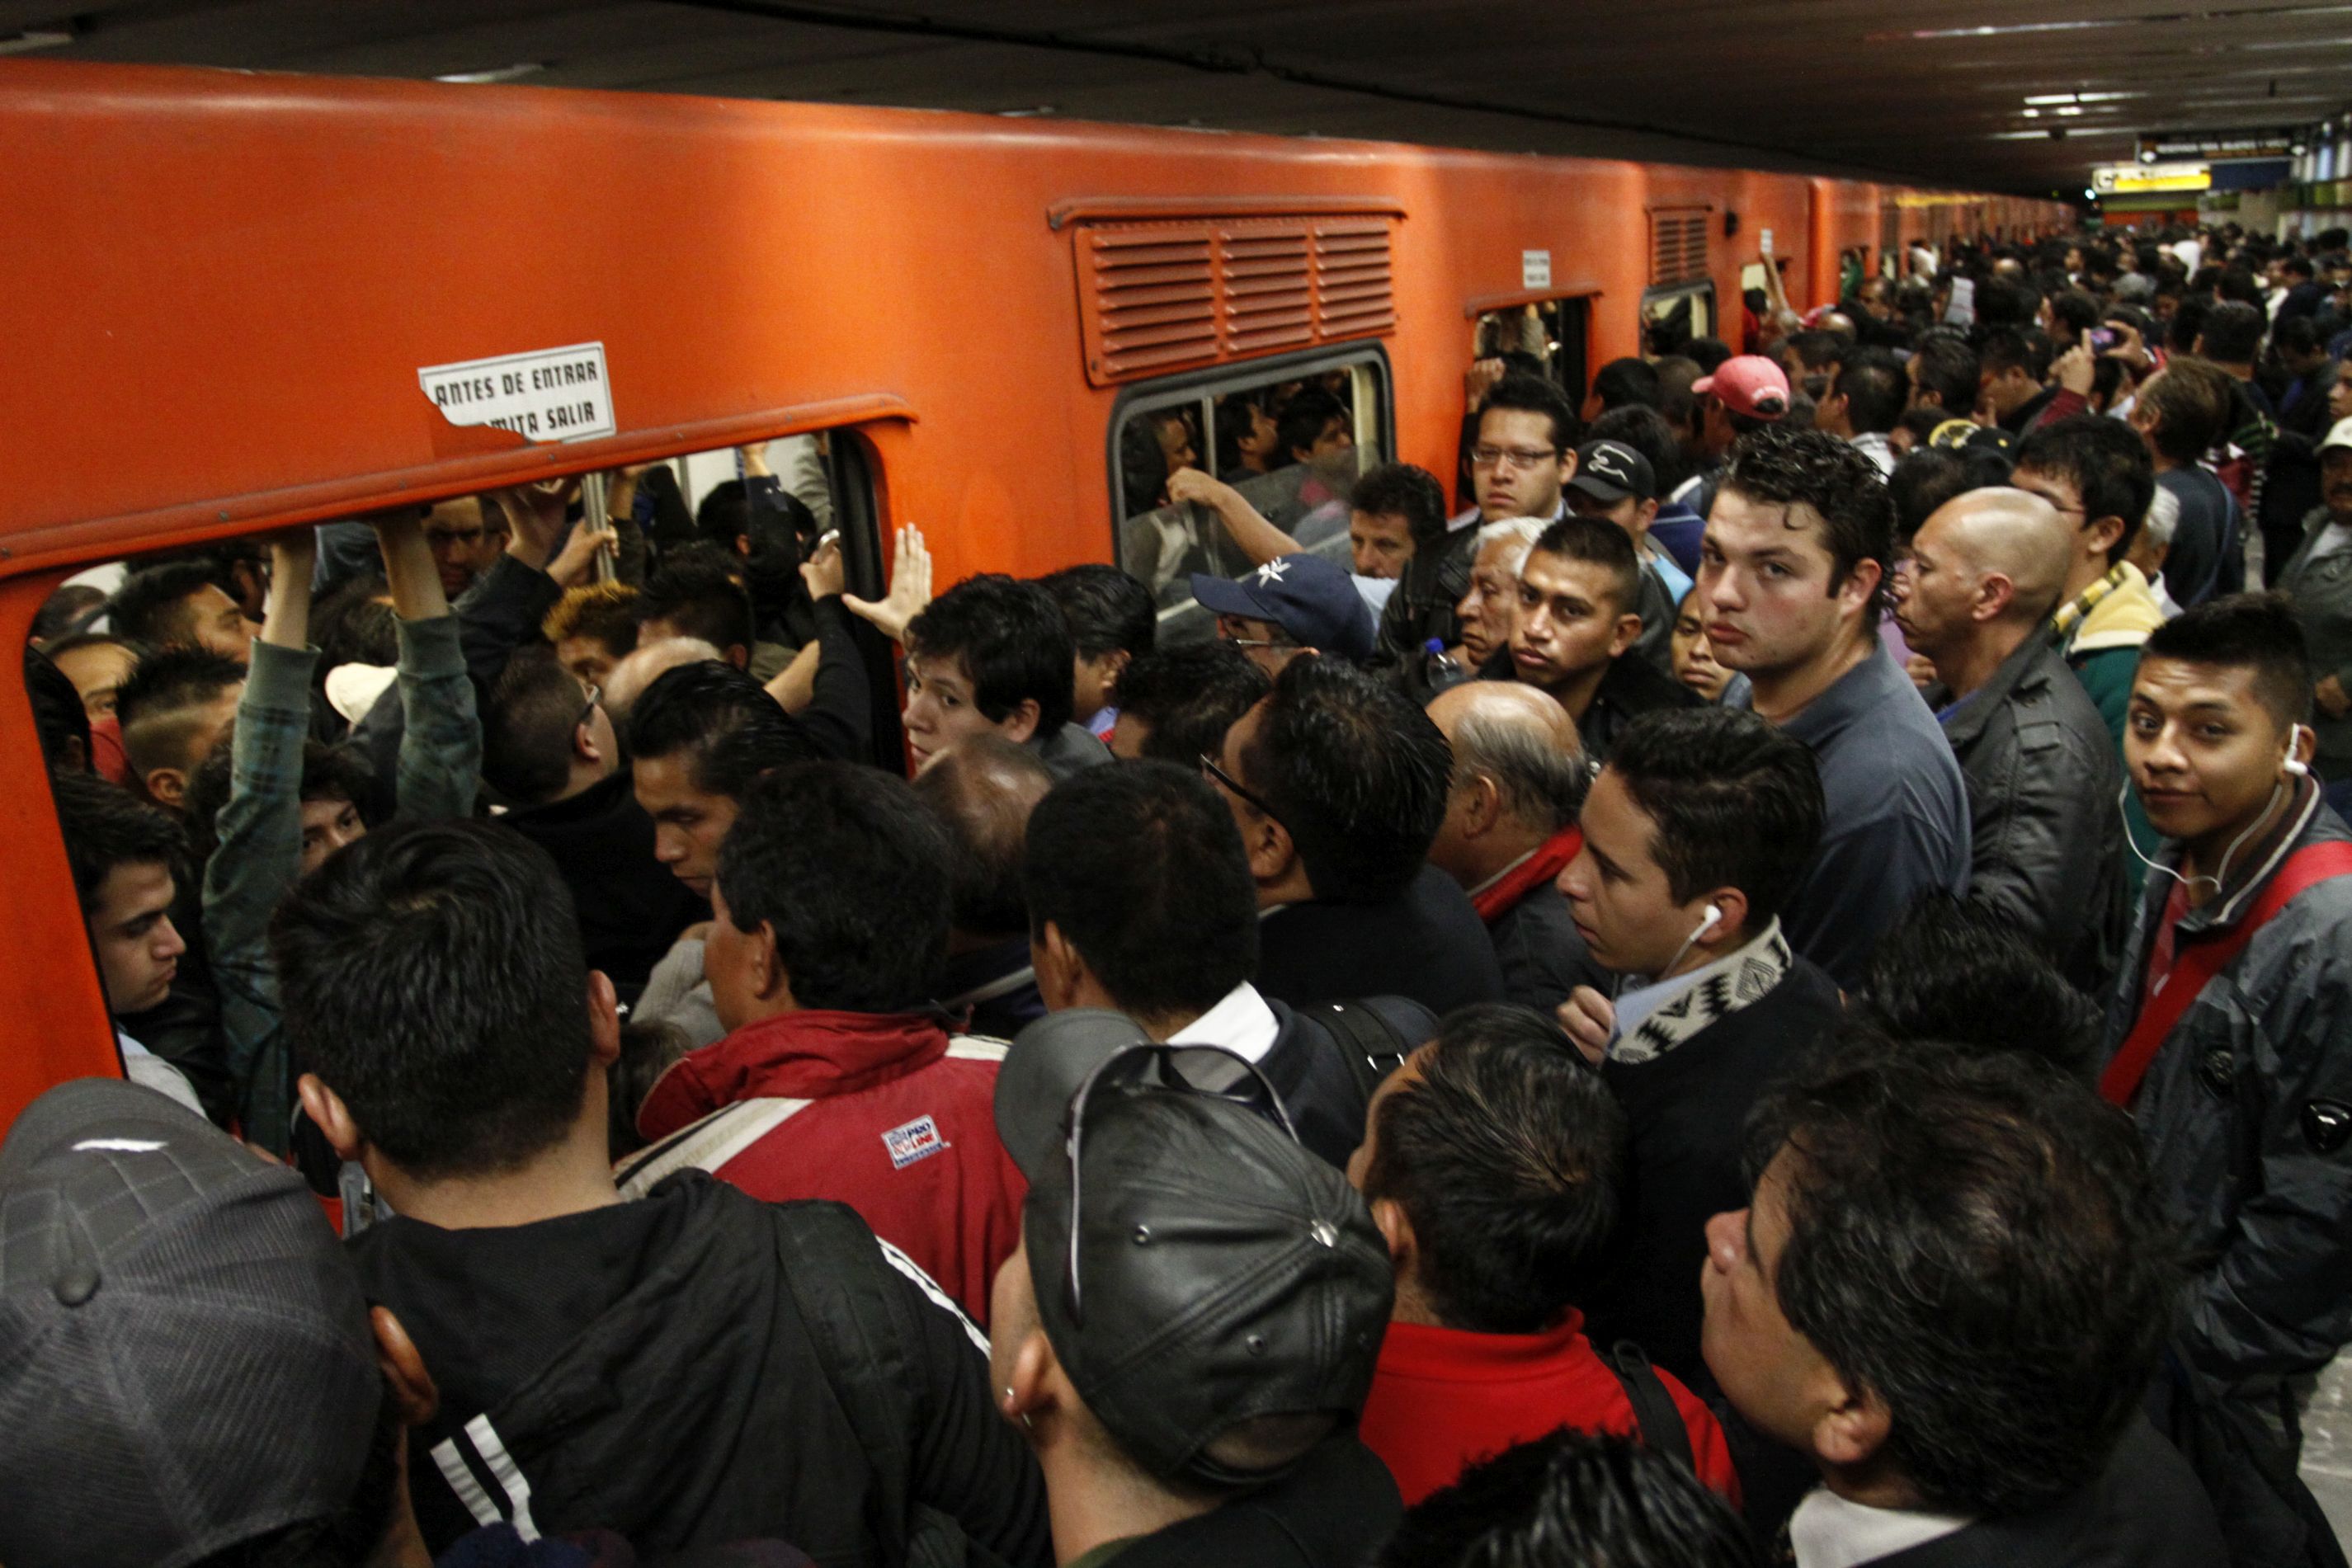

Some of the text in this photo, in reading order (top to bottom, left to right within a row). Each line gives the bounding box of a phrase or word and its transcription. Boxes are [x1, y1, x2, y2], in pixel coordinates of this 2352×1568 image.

[434, 360, 599, 407] ANTES DE ENTRAR
[546, 401, 595, 429] SALIR
